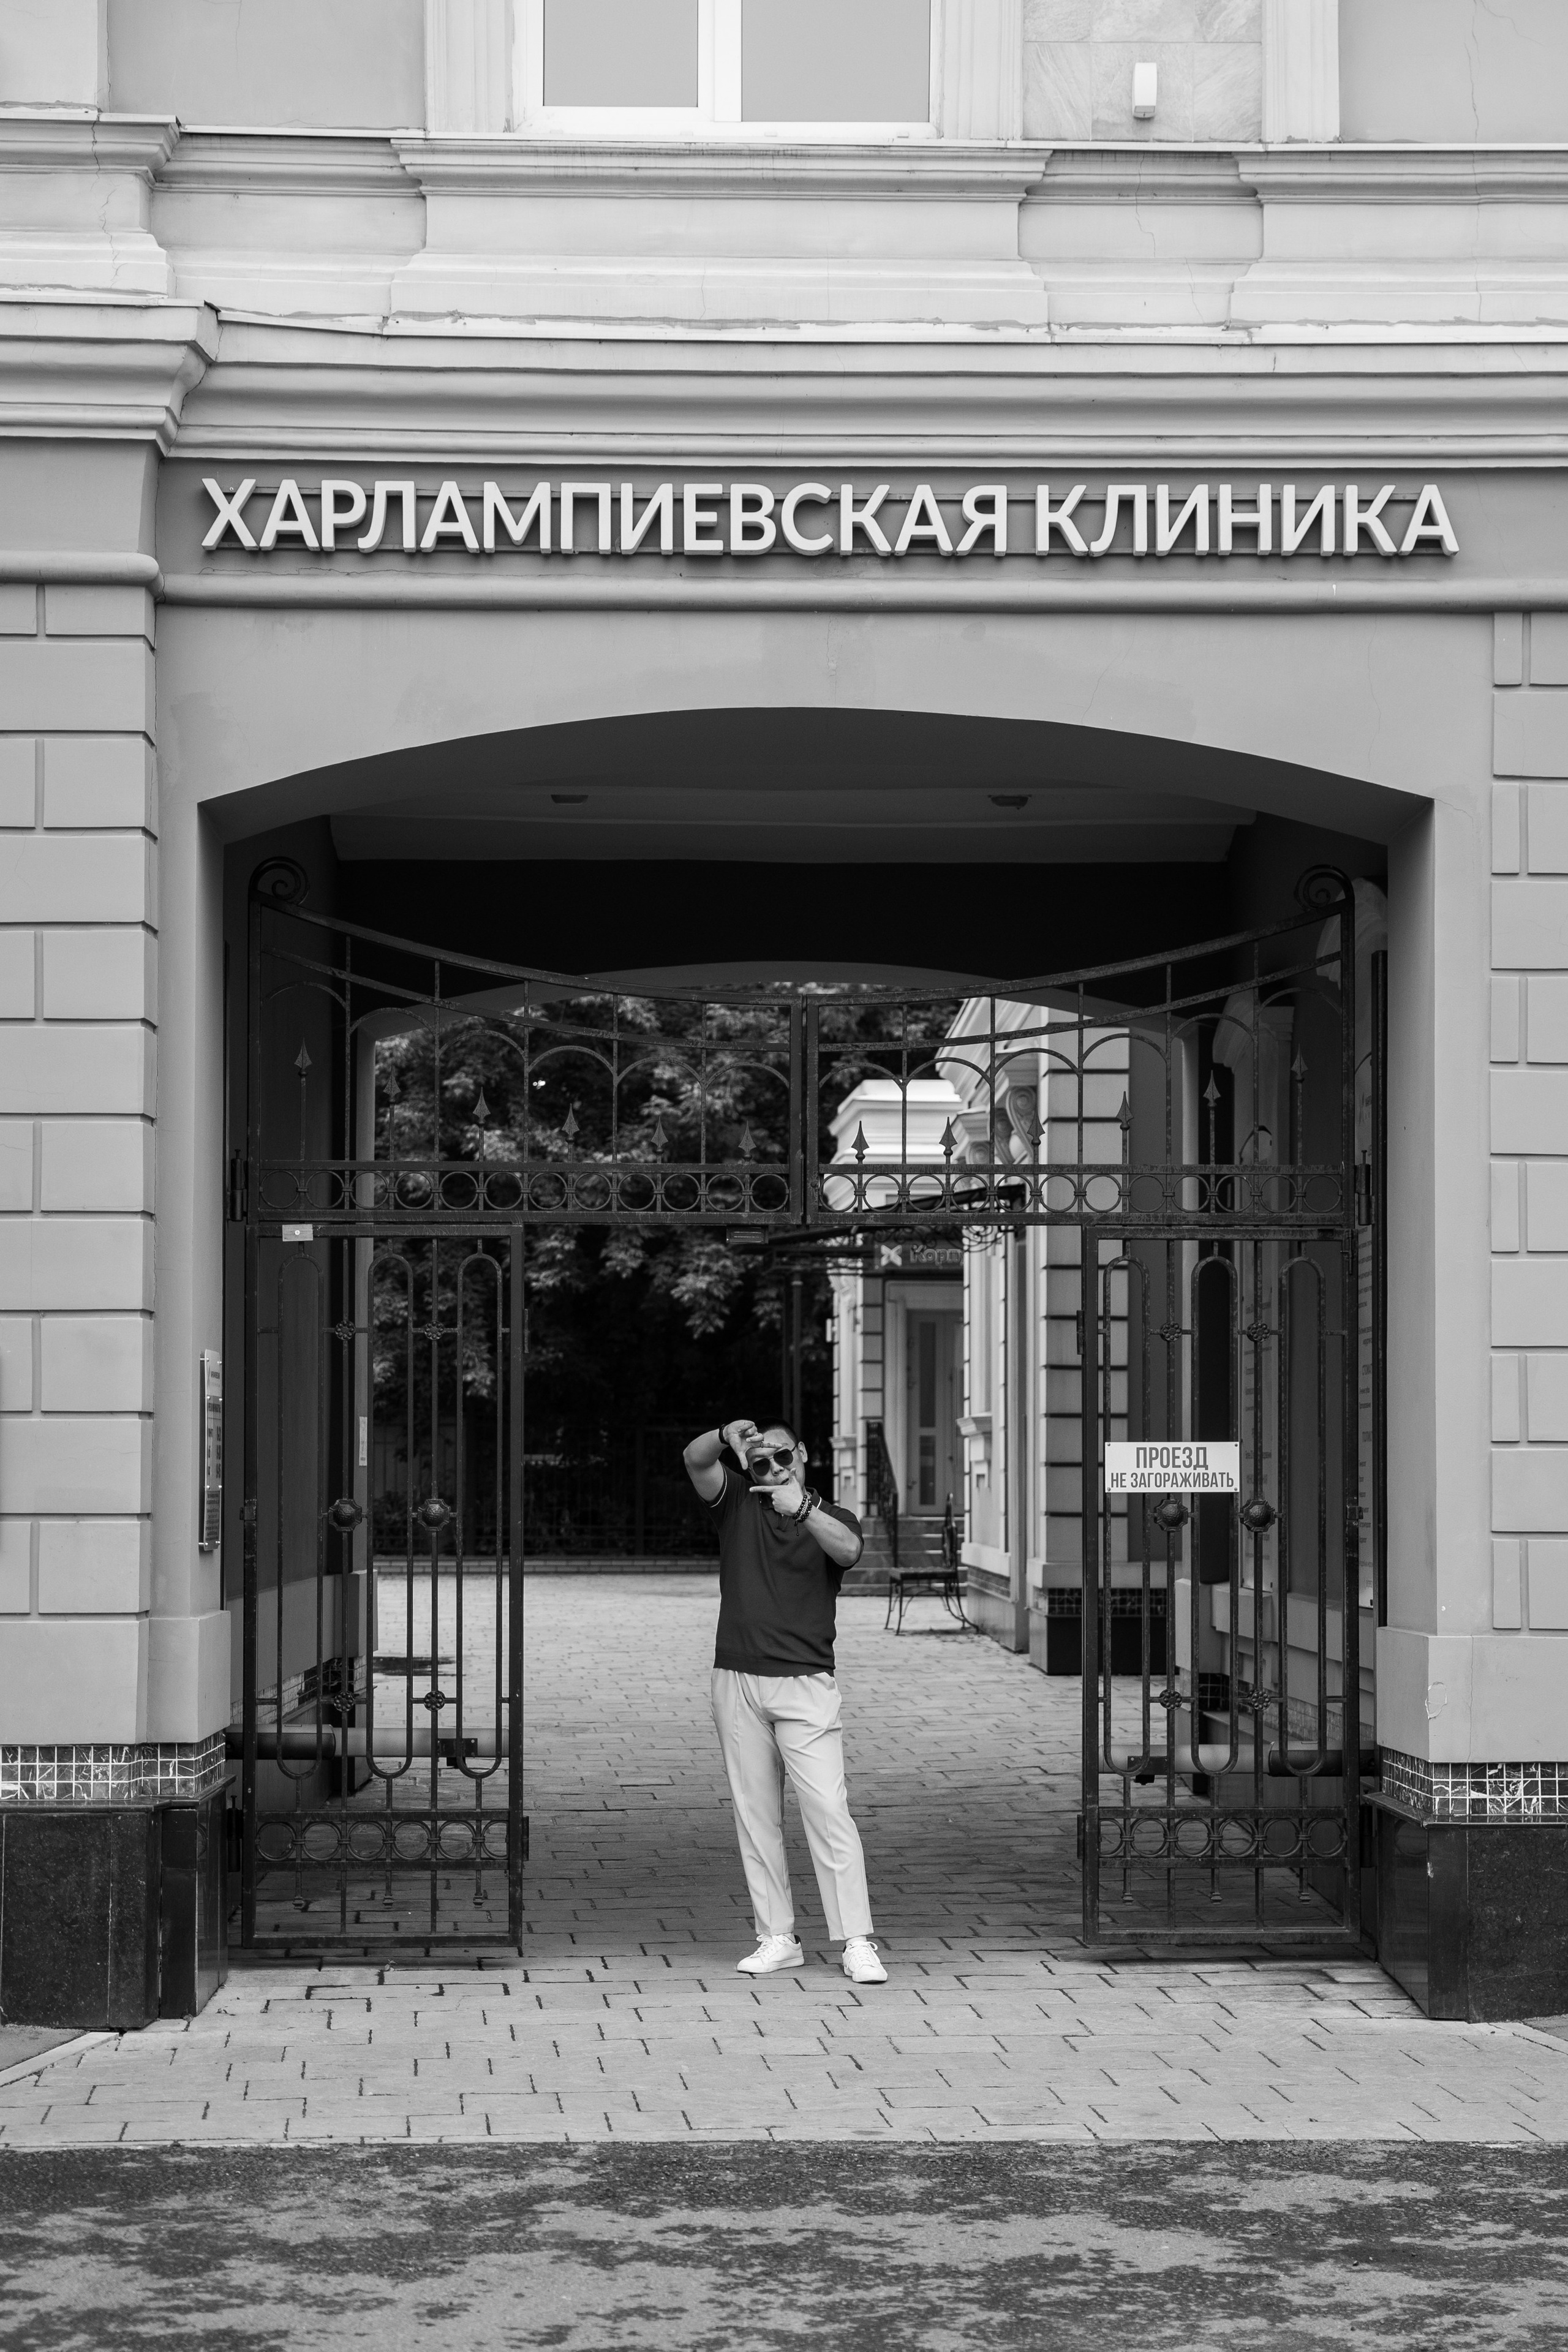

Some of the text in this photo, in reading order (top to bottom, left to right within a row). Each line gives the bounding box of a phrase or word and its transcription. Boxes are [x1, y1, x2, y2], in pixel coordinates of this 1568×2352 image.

[202, 478, 1460, 556] ХАРЛАМПИЕВСКАЯ КЛИНИКА
[1136, 1447, 1208, 1470] ПРОЕЗД
[1111, 1472, 1234, 1488] НЕ ЗАГОРАЖИВАТЬ
